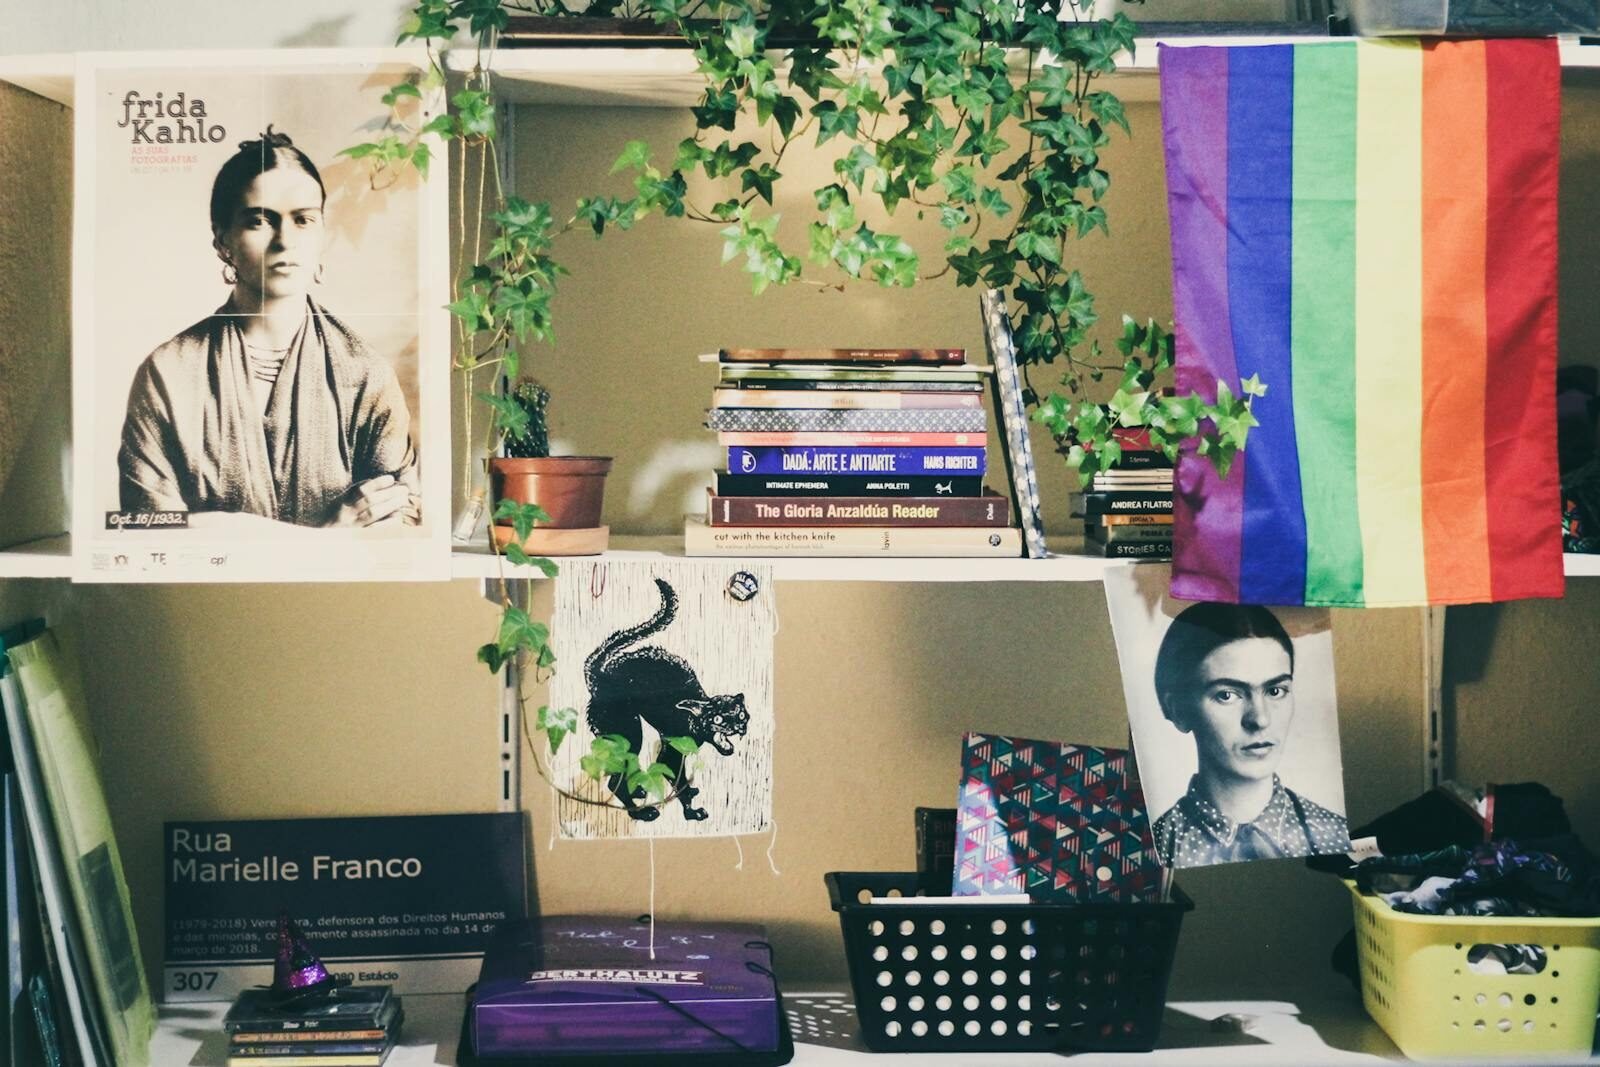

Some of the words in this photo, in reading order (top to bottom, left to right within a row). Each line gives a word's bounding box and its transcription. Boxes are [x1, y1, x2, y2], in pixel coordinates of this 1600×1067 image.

[117, 90, 207, 128] frida
[131, 118, 226, 144] Kahlo
[813, 454, 838, 471] ARTE
[841, 454, 847, 471] E
[850, 454, 896, 472] ANTIARTE
[923, 455, 944, 469] HANS
[945, 455, 978, 469] RICHTER
[766, 481, 794, 490] INTIMATE
[795, 481, 829, 490] EPHEMERA
[866, 482, 884, 490] ANNA
[884, 482, 910, 490] POLETTI
[755, 504, 780, 518] The
[784, 503, 823, 518] Gloria
[827, 503, 889, 518] Anzaldúa
[892, 504, 940, 518] Reader
[1111, 501, 1142, 509] ANDREA
[1143, 501, 1173, 509] FILATRO
[714, 533, 728, 541] cut
[732, 531, 753, 541] with
[756, 531, 771, 541] the
[774, 531, 809, 541] kitchen
[812, 531, 837, 541] knife
[173, 829, 232, 852] Rua
[173, 856, 299, 883] Marielle
[313, 855, 422, 880] Franco
[317, 915, 375, 927] defensora
[379, 914, 399, 925] dos
[403, 913, 448, 923] Direitos
[451, 911, 506, 922] Humanos
[184, 932, 204, 942] das
[208, 932, 261, 943] minorias,
[351, 926, 420, 938] assassinada
[425, 926, 439, 936] no
[442, 924, 460, 935] dia
[464, 923, 478, 934] 14
[212, 944, 227, 954] de
[230, 943, 261, 954] 2018.
[173, 971, 219, 991] 307
[358, 970, 399, 981] Estácio
